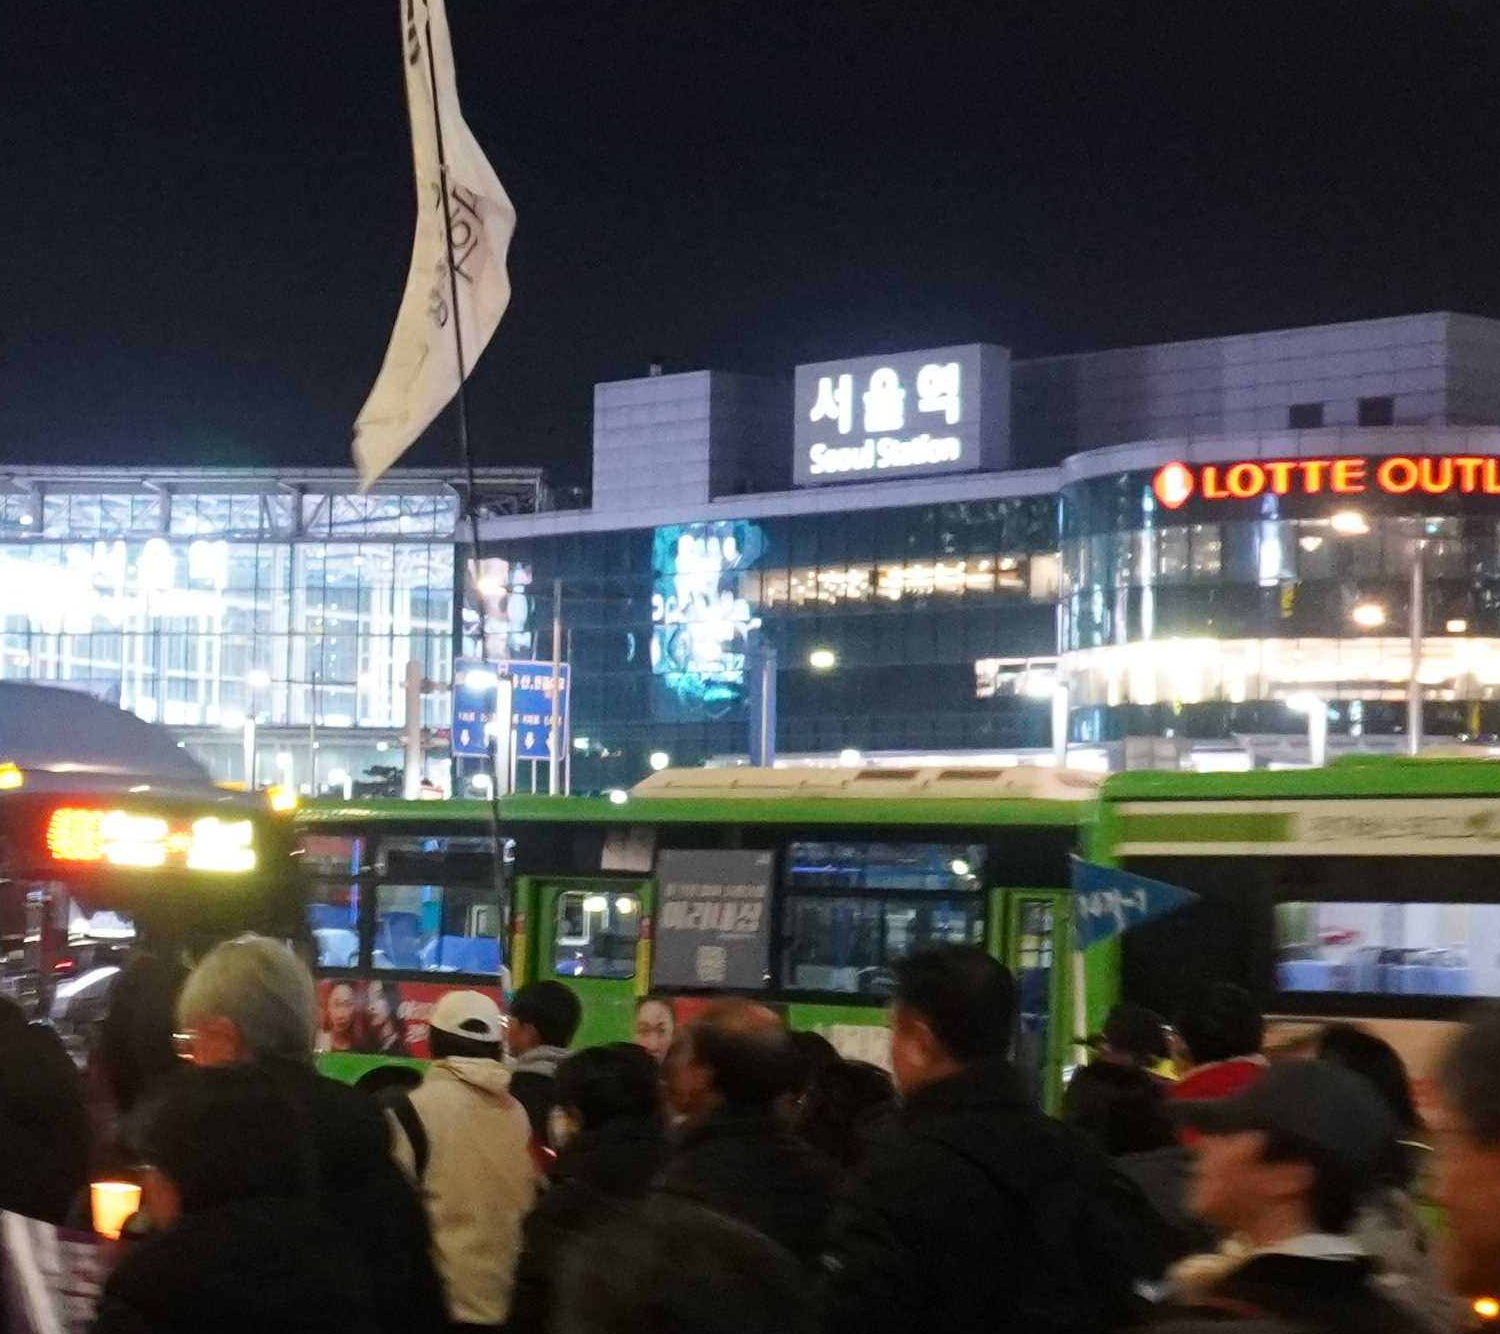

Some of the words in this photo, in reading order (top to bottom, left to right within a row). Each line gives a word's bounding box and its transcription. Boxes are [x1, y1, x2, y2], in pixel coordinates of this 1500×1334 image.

[810, 362, 961, 435] 서울역
[810, 438, 876, 475] Seoul
[876, 433, 962, 469] Station
[1201, 460, 1367, 500] LOTTE
